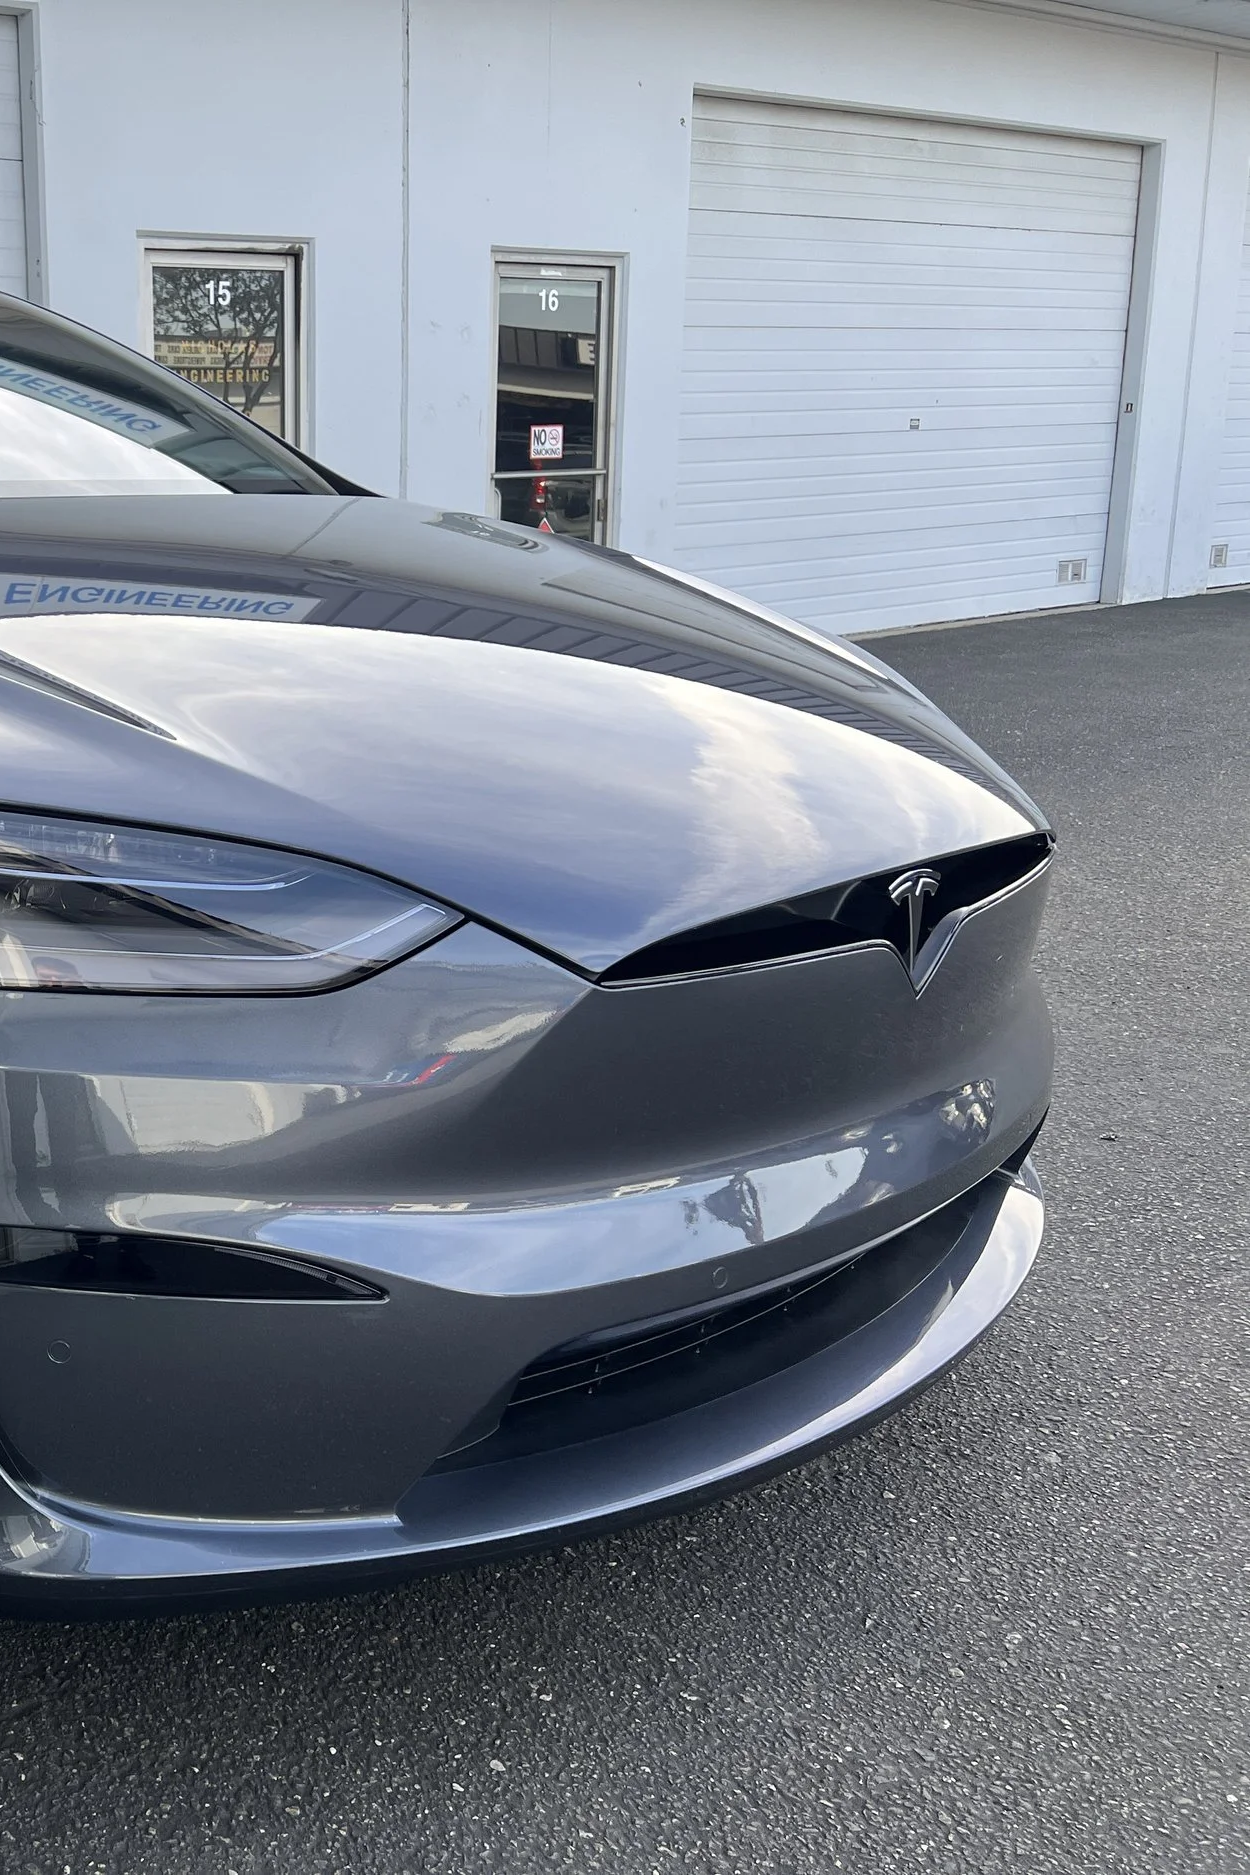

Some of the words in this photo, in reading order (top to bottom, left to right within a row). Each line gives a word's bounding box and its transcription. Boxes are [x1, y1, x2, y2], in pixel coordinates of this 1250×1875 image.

[205, 280, 231, 305] 15
[538, 288, 559, 311] 16
[174, 369, 270, 383] NGINEERING
[533, 428, 547, 446] NO
[532, 447, 561, 457] SMOKING
